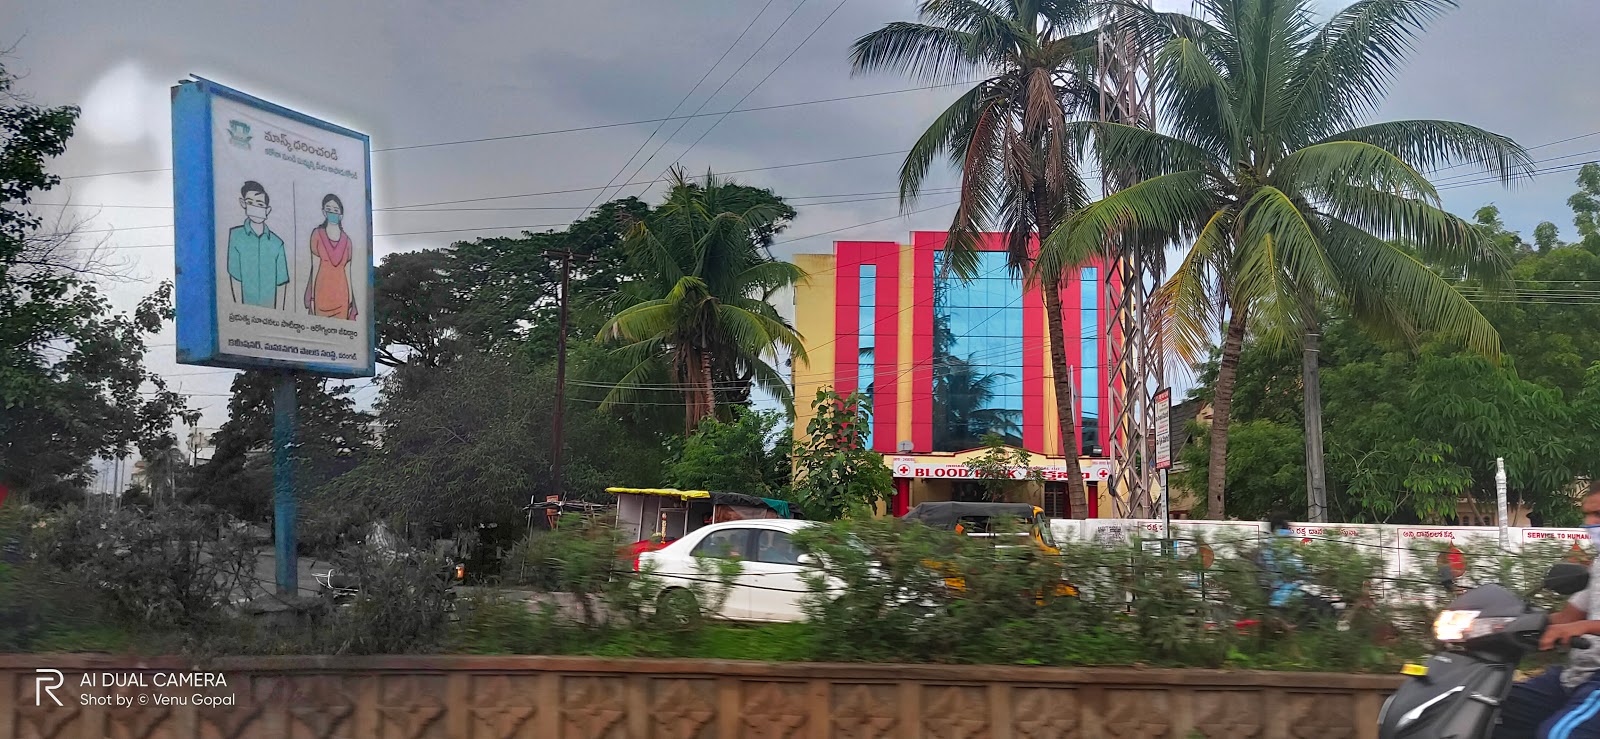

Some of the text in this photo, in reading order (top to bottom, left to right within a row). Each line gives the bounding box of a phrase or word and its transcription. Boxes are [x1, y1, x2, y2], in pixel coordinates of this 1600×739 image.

[264, 131, 338, 160] మాస్క్ ధరించండి
[915, 468, 968, 478] BLOOD
[974, 470, 1017, 479] BAK
